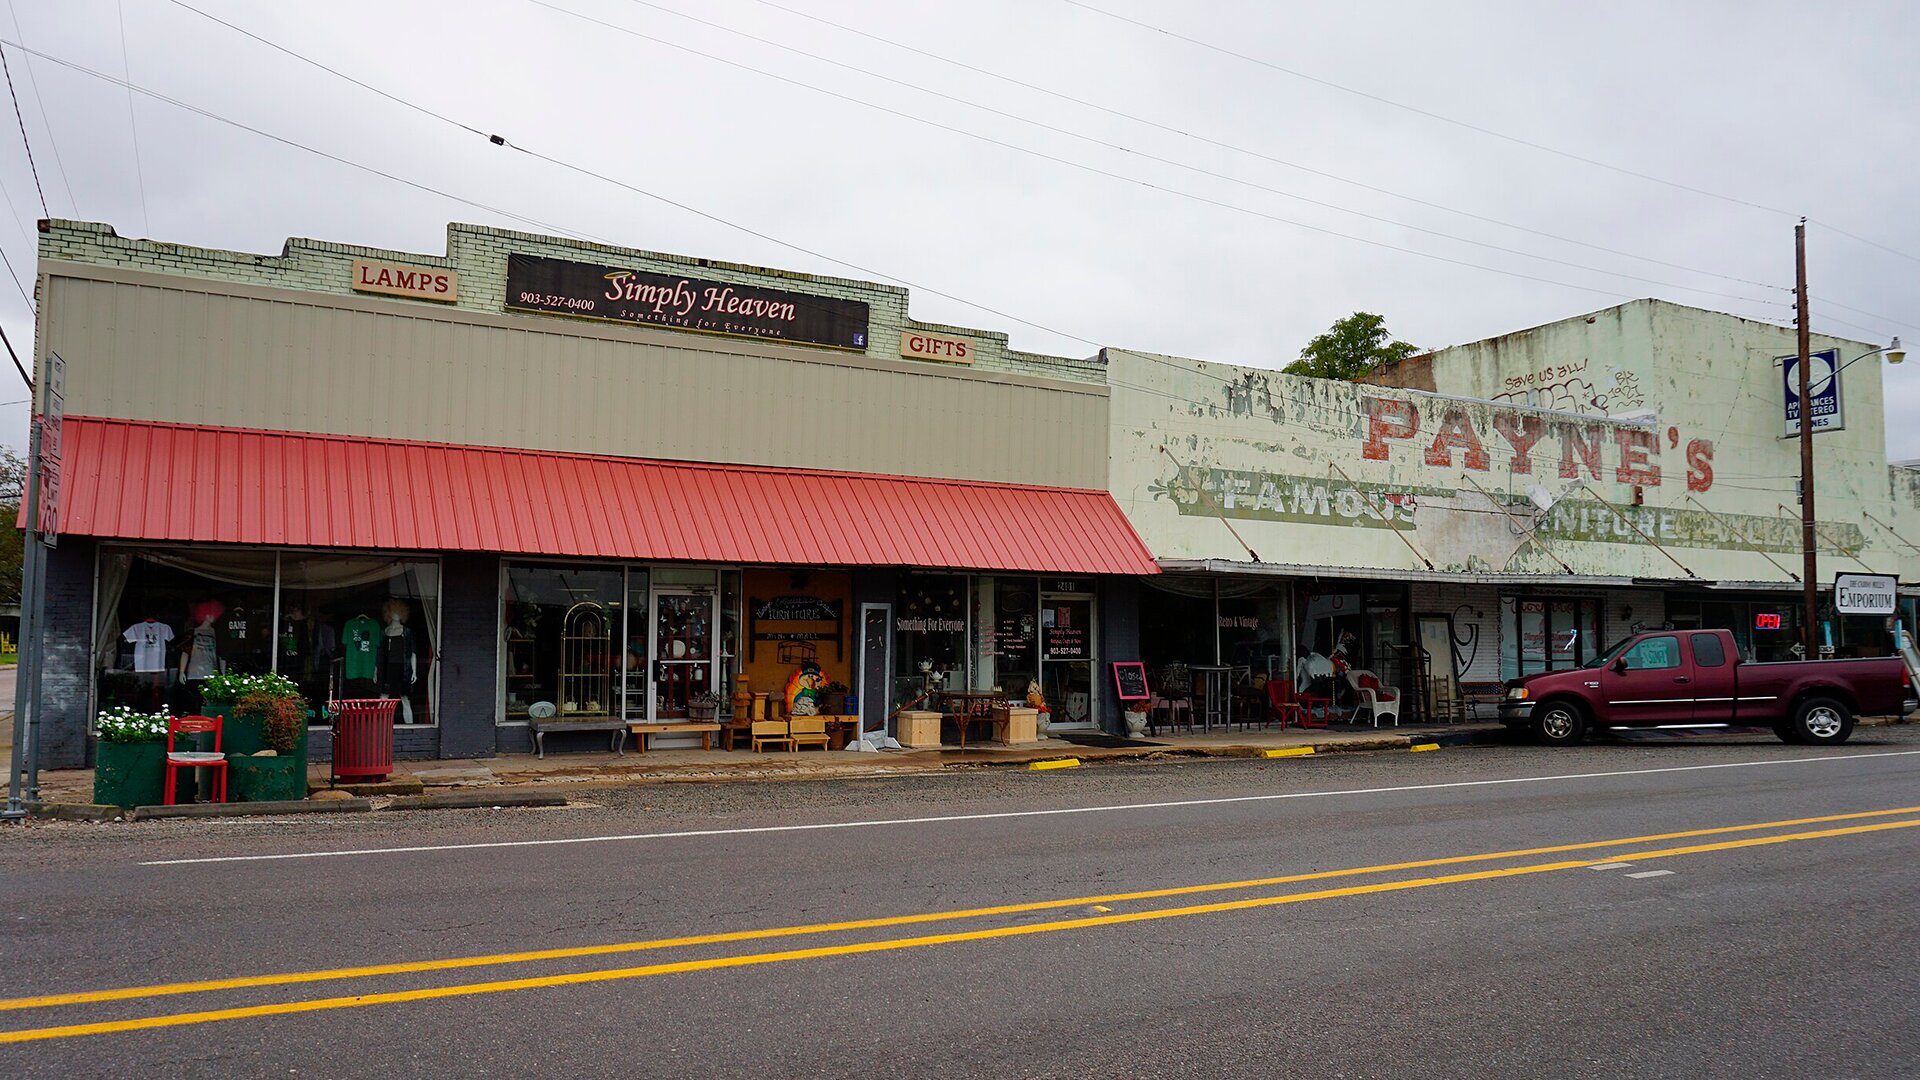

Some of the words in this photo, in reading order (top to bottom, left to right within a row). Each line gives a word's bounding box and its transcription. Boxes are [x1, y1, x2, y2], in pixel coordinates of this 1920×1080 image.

[361, 266, 449, 293] LAMPS
[520, 291, 595, 311] 903-527-0400
[605, 273, 697, 316] Simply
[701, 287, 796, 321] Heaven
[620, 309, 689, 327] Something
[696, 318, 717, 329] for
[724, 322, 782, 336] Everyone
[909, 336, 967, 357] GIFTS
[1787, 396, 1834, 410] APANCES
[1788, 409, 1799, 419] TV
[1809, 404, 1835, 415] TEREO
[1795, 418, 1829, 430] PNES
[1362, 398, 1714, 493] PAYNE'S
[1222, 478, 1415, 523] FAMOUS
[1839, 587, 1892, 609] EMPORIUM
[896, 616, 927, 634] Something
[927, 617, 938, 631] For
[938, 617, 965, 635] Everyone
[1756, 614, 1781, 629] OPEN
